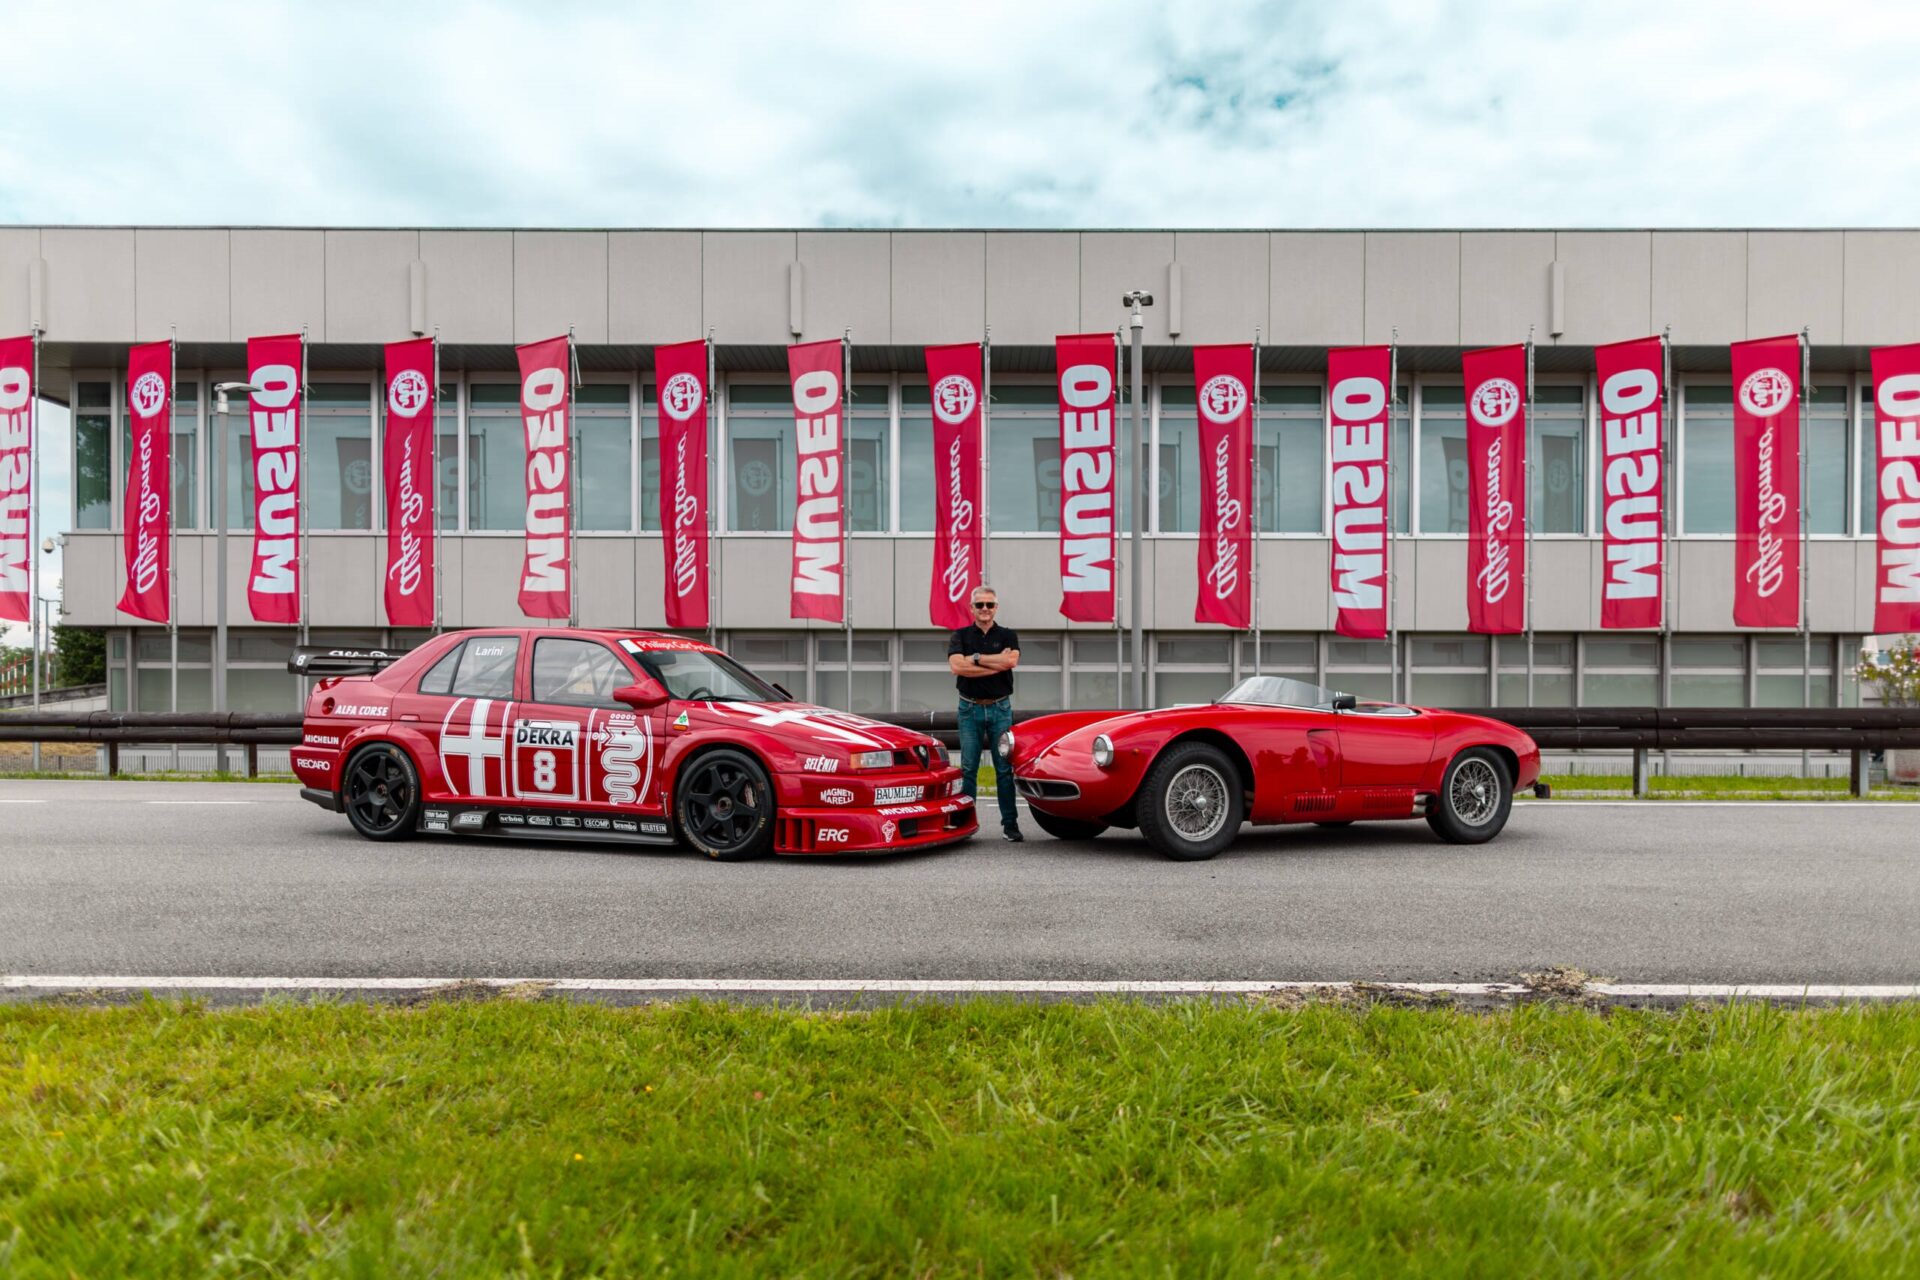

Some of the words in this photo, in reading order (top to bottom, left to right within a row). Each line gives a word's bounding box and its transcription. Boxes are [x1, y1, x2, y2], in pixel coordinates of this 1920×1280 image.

[475, 646, 504, 656] Larini
[296, 654, 306, 666] 8
[334, 704, 358, 715] ALFA
[358, 705, 389, 716] CORSE
[304, 734, 339, 745] MICHELIN
[516, 728, 574, 746] DEKRA
[296, 758, 330, 771] RECARO
[533, 750, 556, 791] 8
[877, 805, 928, 816] MICHELIN
[641, 823, 667, 833] BILSTEIN
[817, 828, 850, 842] ERG
